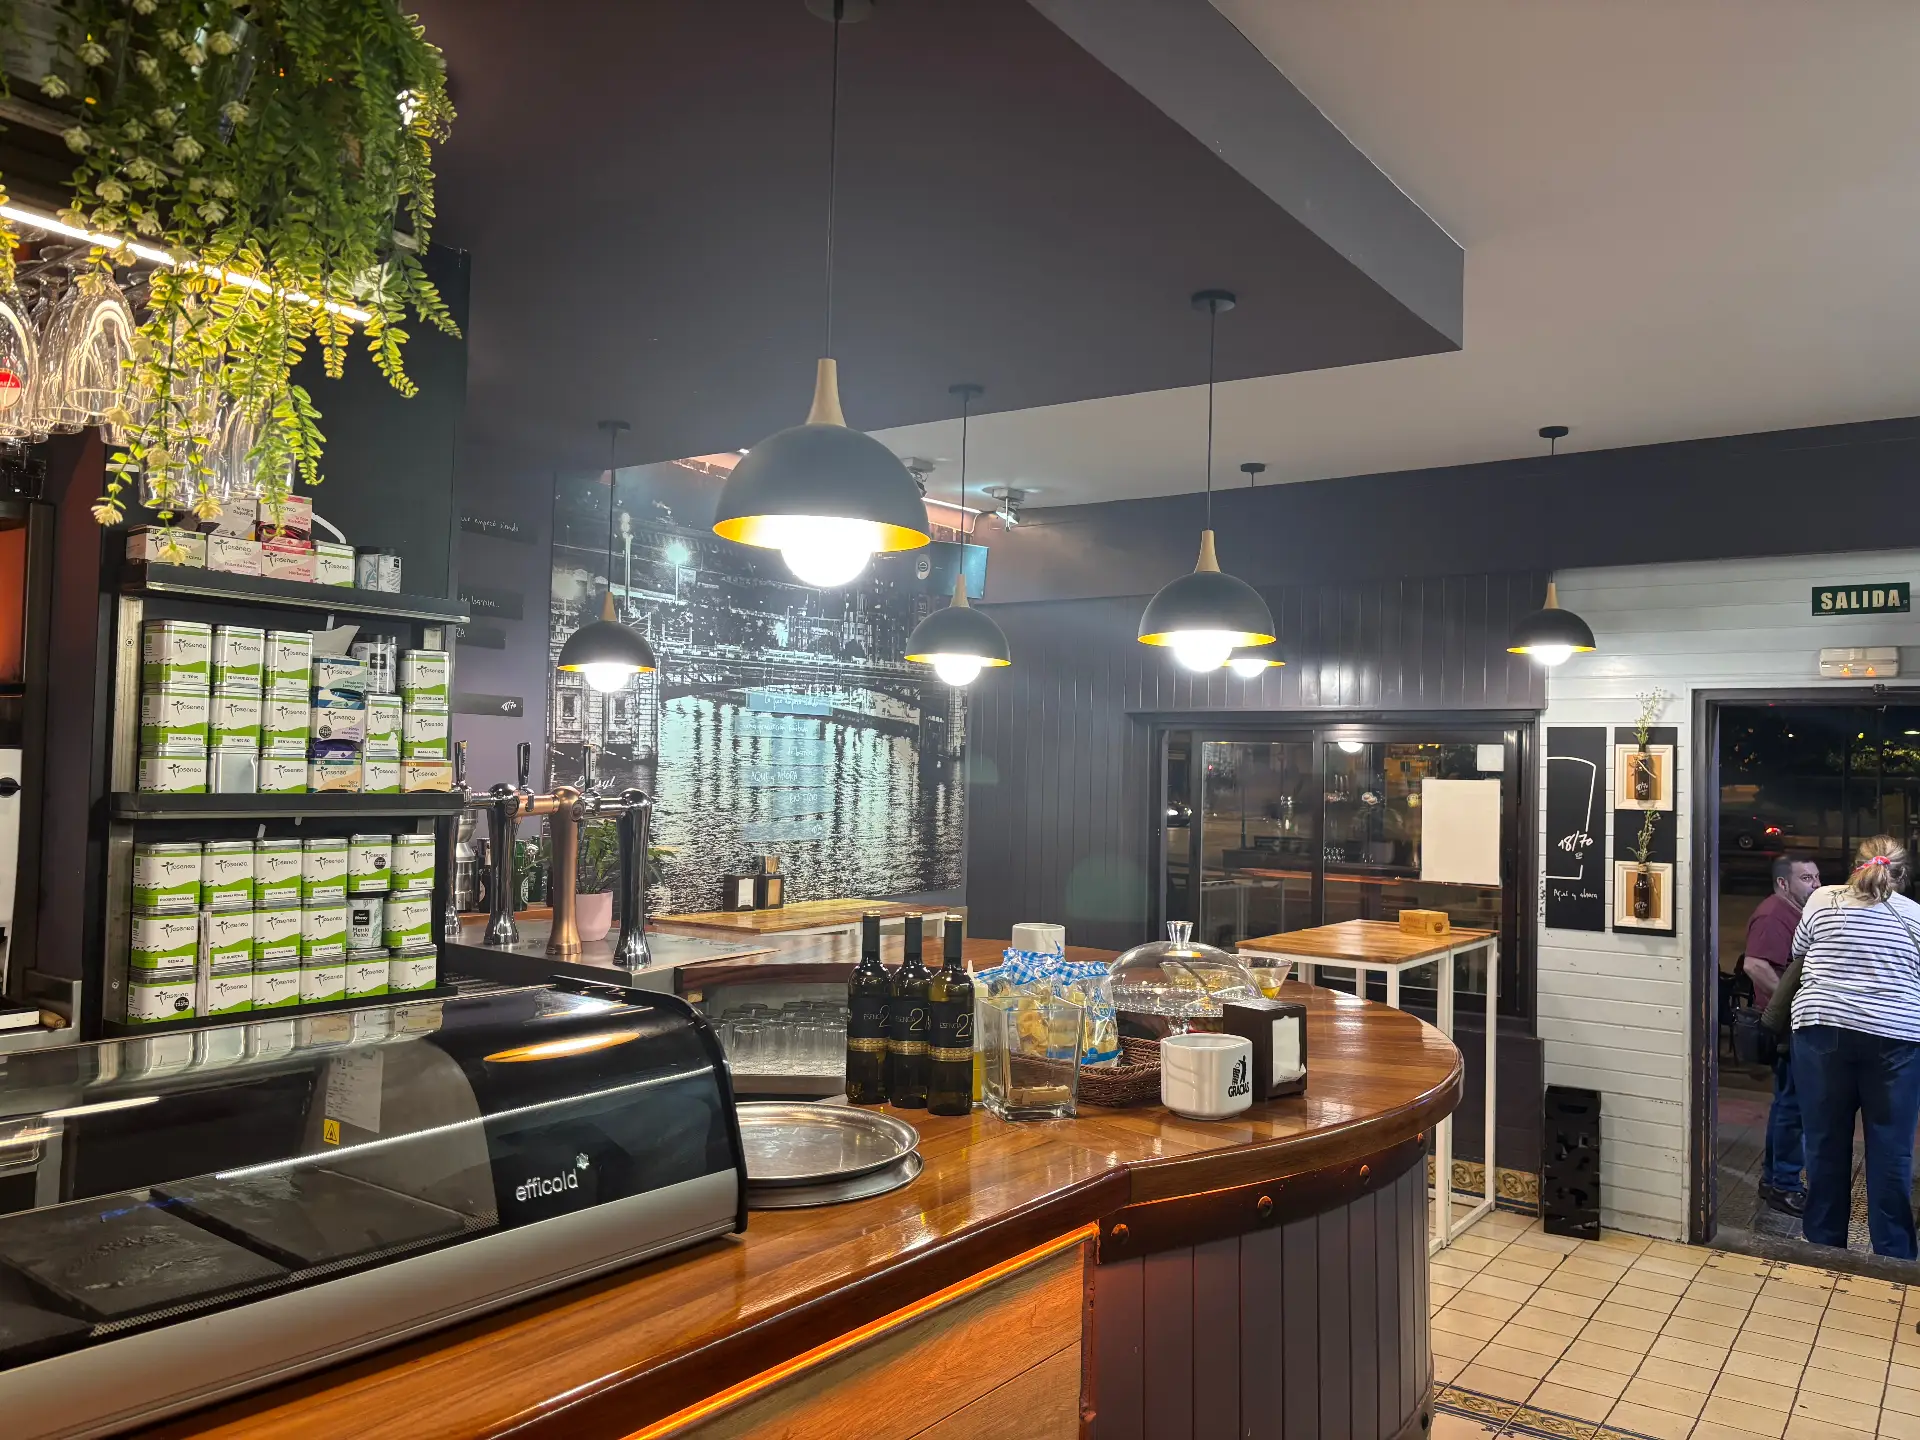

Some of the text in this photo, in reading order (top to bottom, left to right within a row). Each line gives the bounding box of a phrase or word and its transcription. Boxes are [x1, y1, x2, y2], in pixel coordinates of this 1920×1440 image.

[1820, 589, 1900, 610] SALIDA
[1558, 830, 1594, 852] 18/70
[1228, 1082, 1250, 1098] GRACIAS
[515, 1168, 578, 1202] efficold
